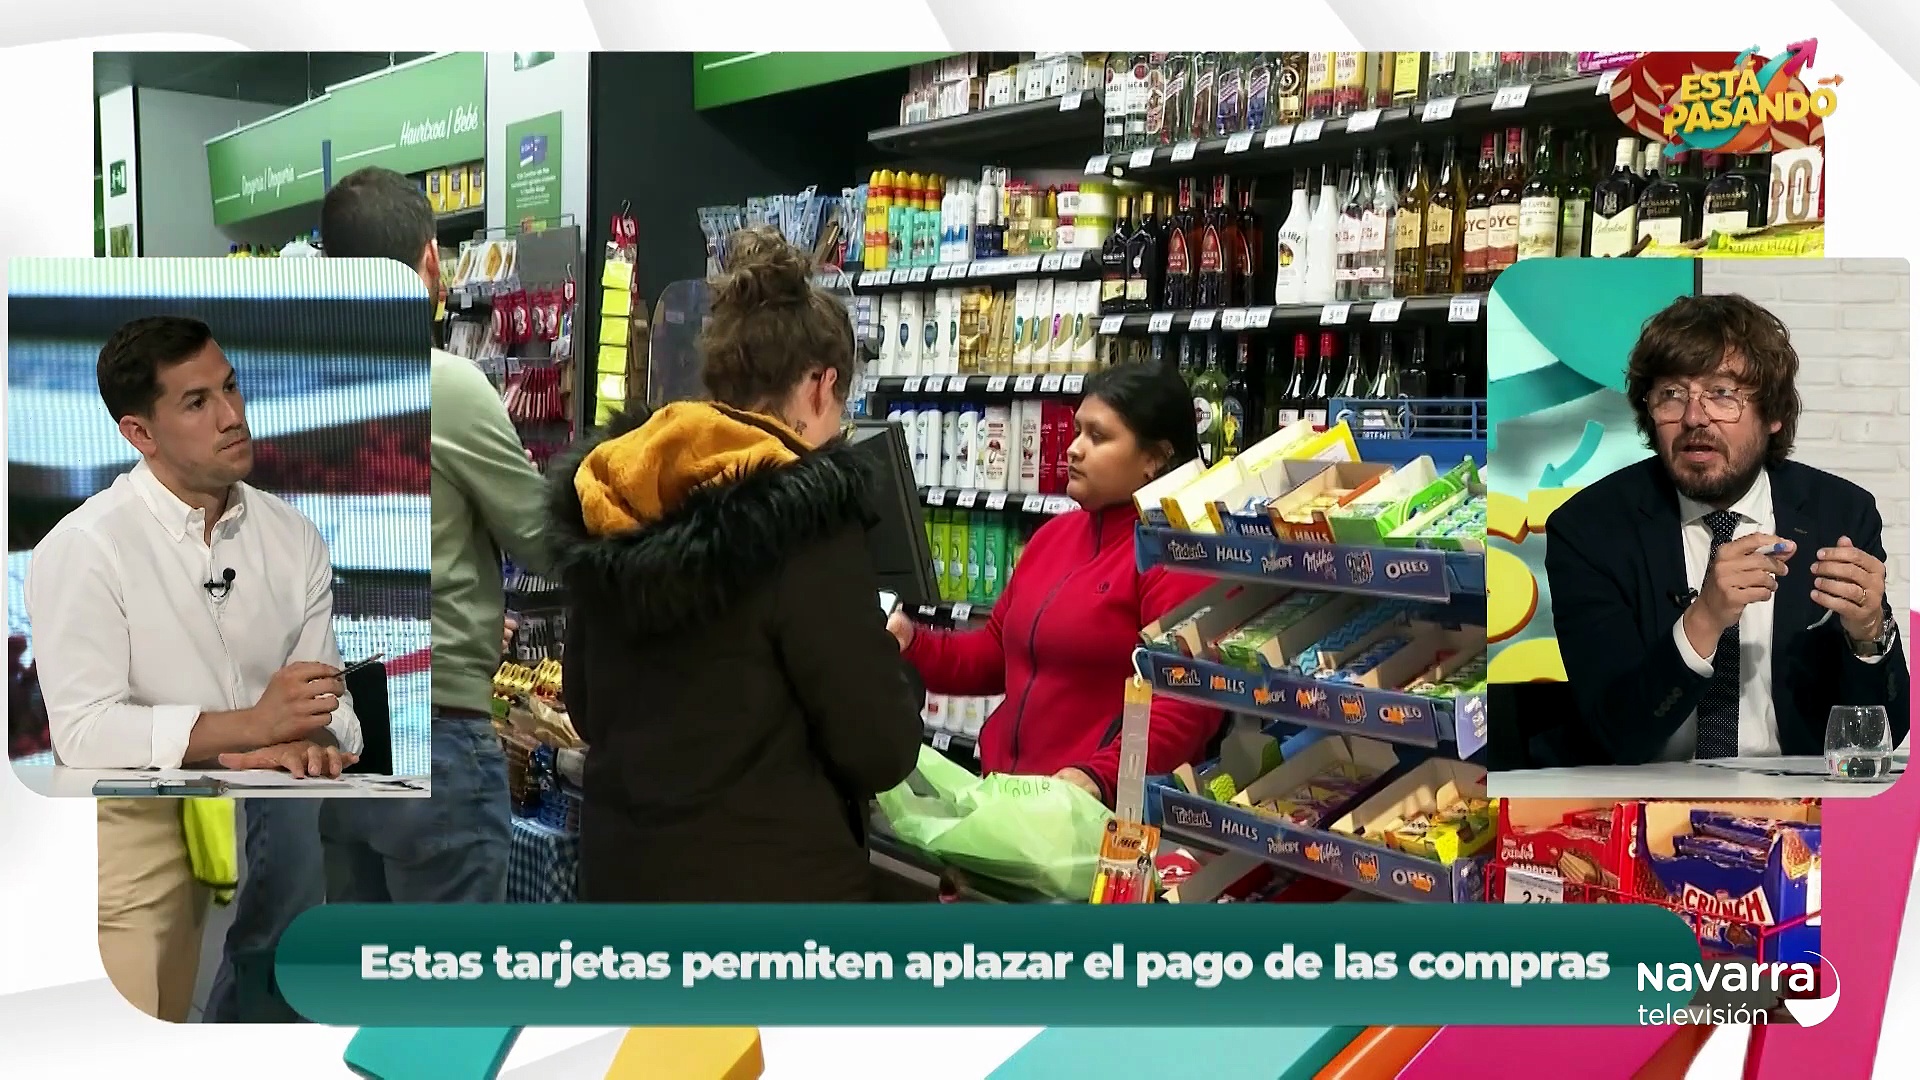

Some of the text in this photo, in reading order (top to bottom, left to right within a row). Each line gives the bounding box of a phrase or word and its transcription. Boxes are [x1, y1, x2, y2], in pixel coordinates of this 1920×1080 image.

[400, 115, 445, 147] Haurtxoa
[453, 102, 479, 134] Bebé
[1490, 215, 1518, 229] DYC
[1241, 523, 1272, 537] HALLS
[1294, 530, 1331, 544] HALLS
[1215, 544, 1253, 565] HALLS
[1302, 547, 1336, 574] Milka
[1384, 560, 1430, 580] OREO
[1210, 674, 1245, 695] HLLS
[1379, 705, 1422, 725] OEO
[1221, 817, 1259, 841] HALLS
[1685, 889, 1767, 923] CRUNCH
